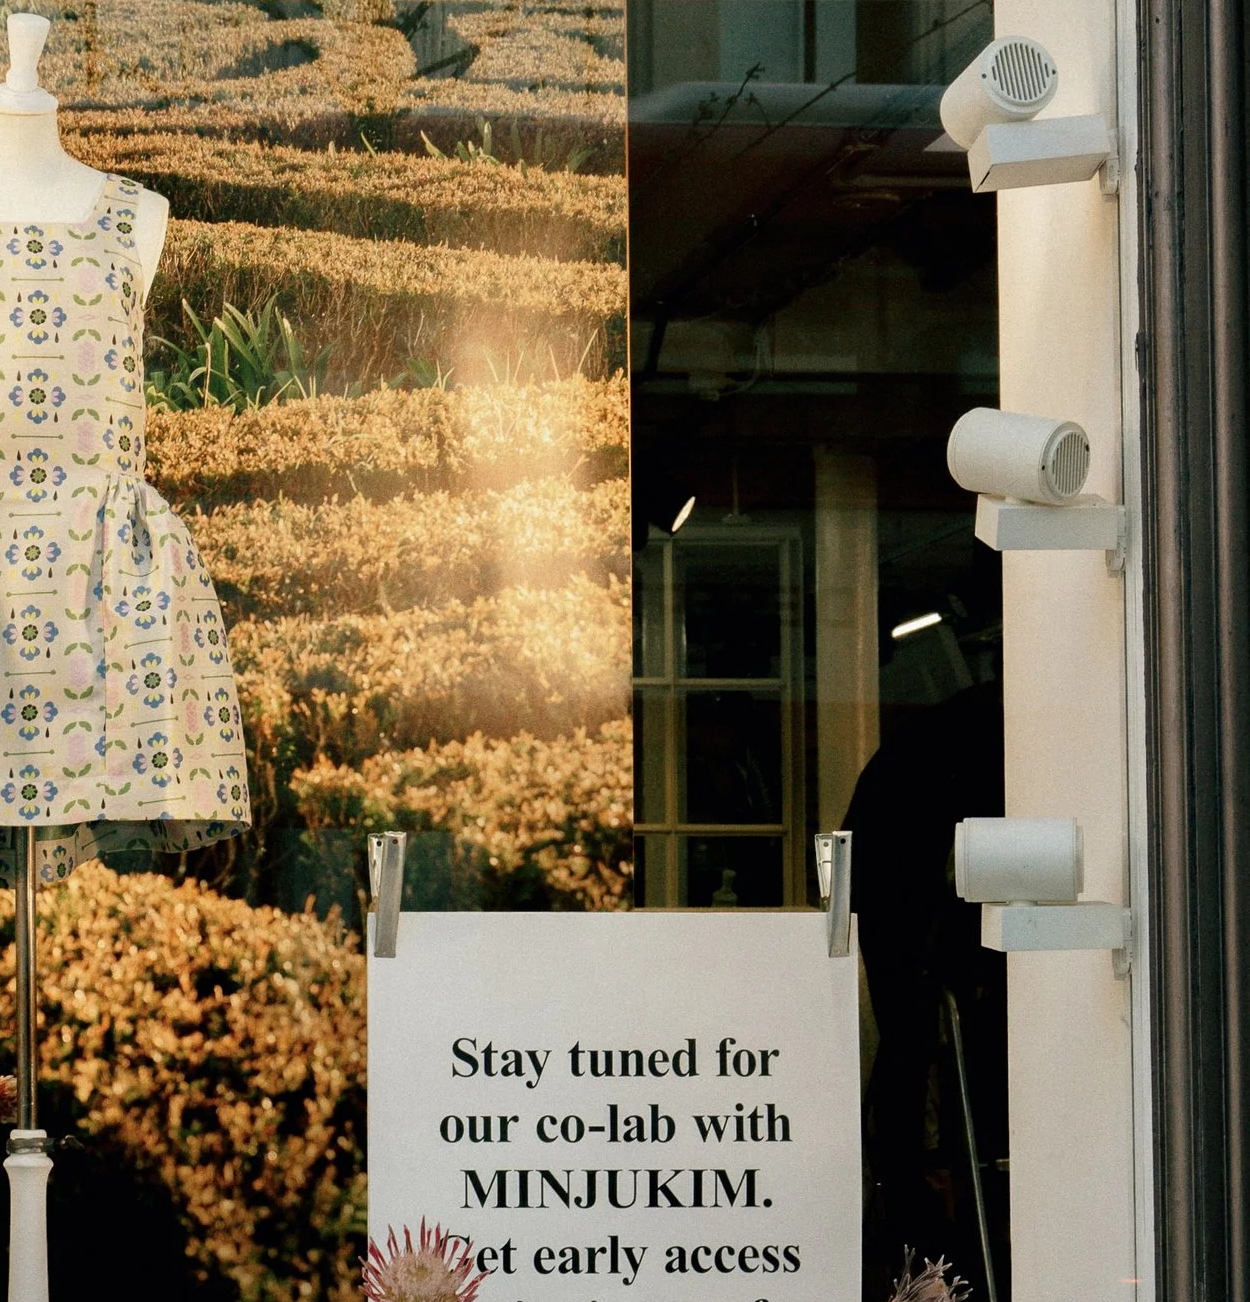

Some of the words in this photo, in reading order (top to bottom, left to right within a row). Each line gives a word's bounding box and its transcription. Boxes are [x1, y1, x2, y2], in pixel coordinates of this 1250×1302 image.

[451, 1037, 551, 1088] Stay
[568, 1038, 699, 1078] tuned
[715, 1037, 780, 1078] for
[439, 1114, 519, 1143] our
[536, 1104, 676, 1143] co-lab
[693, 1102, 792, 1143] with
[460, 1169, 773, 1209] MINJUKIM.
[533, 1235, 647, 1286] early
[664, 1245, 801, 1274] access
